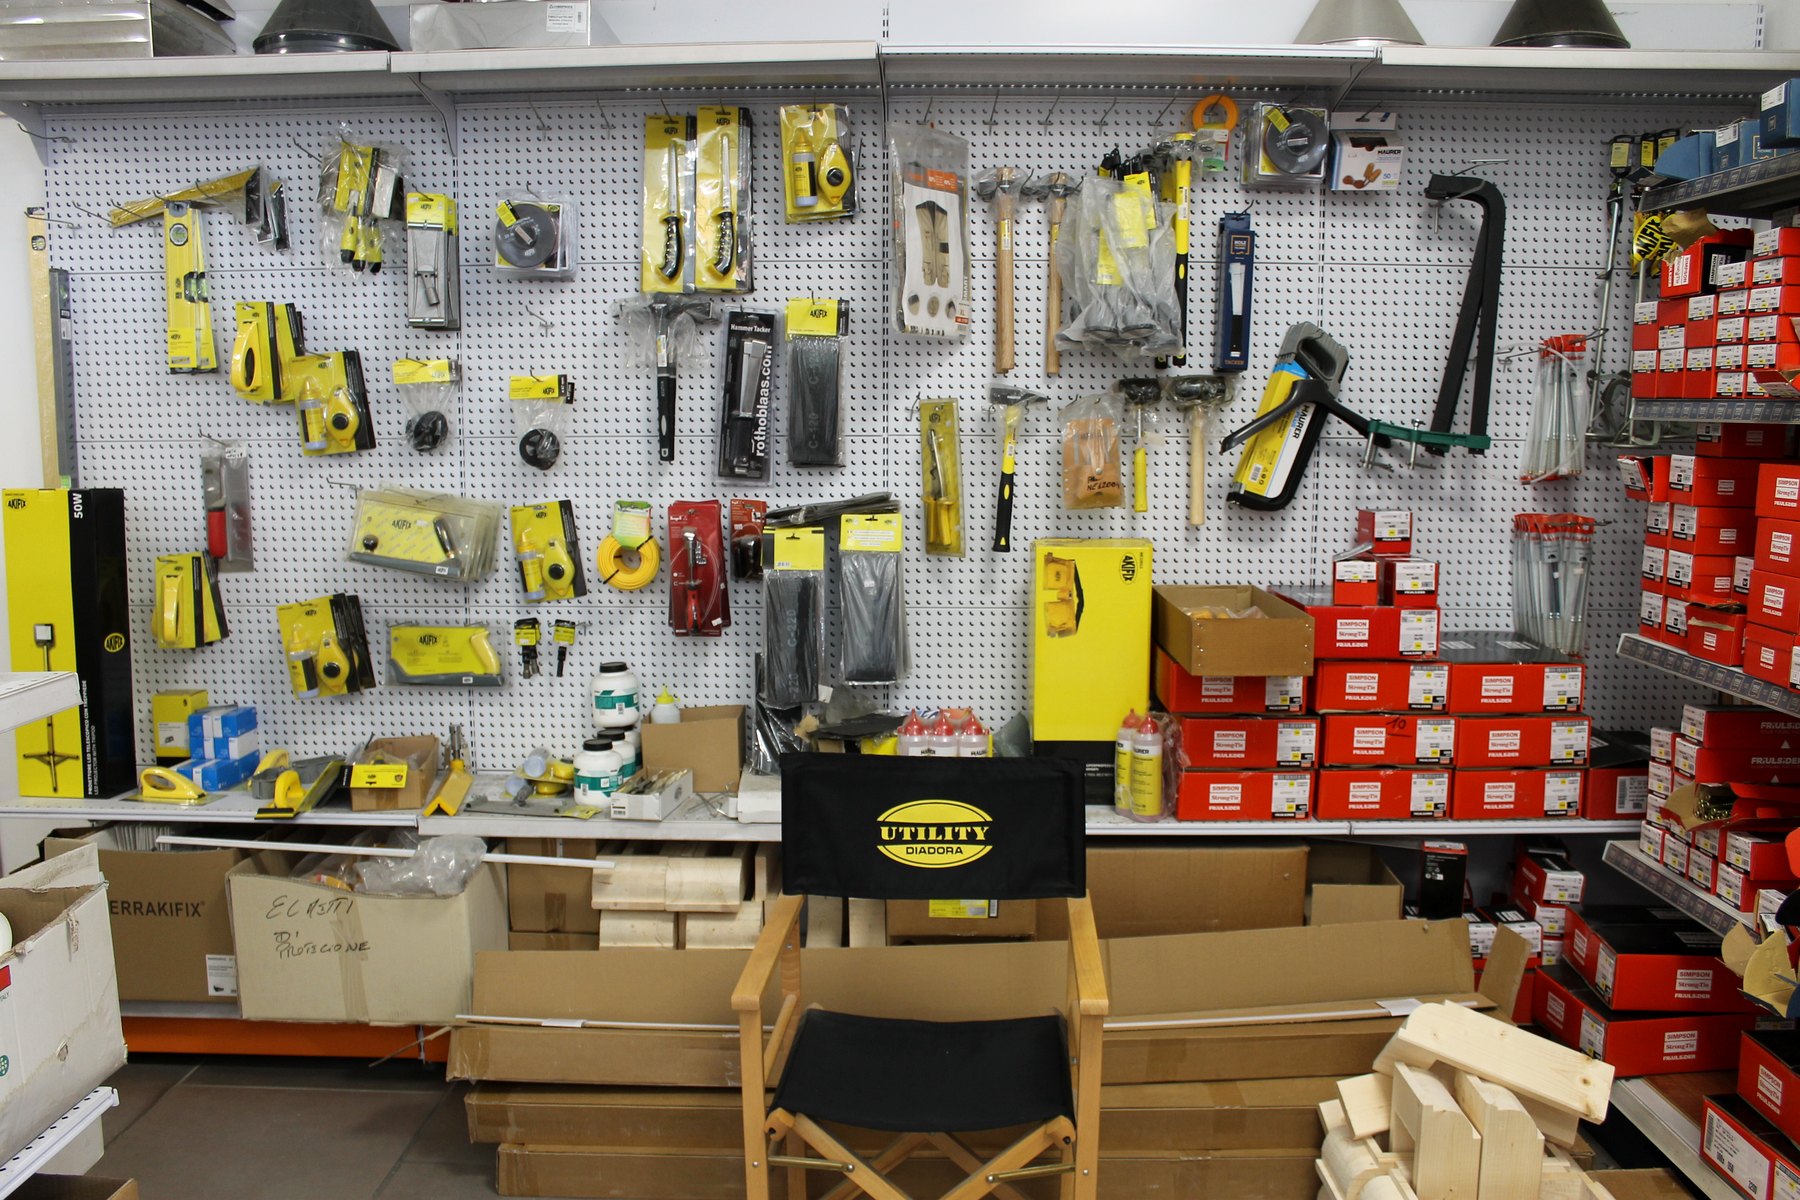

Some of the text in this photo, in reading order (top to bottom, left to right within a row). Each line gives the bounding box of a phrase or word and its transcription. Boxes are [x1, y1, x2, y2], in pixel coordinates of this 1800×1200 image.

[730, 323, 771, 333] Hammer Tacker
[1292, 404, 1310, 439] MAURER
[7, 498, 26, 510] AKIFIX
[72, 492, 84, 519] 50W
[391, 519, 412, 530] AKIFIX
[1120, 555, 1136, 582] AKIFIX
[787, 609, 797, 648] C-220
[106, 632, 123, 650] AKIFIX
[418, 635, 438, 647] AKIFIX
[880, 826, 990, 841] UTILITY
[905, 846, 964, 855] DIADORA
[109, 900, 202, 918] ERRAKIFIX
[1666, 1031, 1696, 1040] SIMPSON
[1760, 1067, 1782, 1090] SIMPSON
